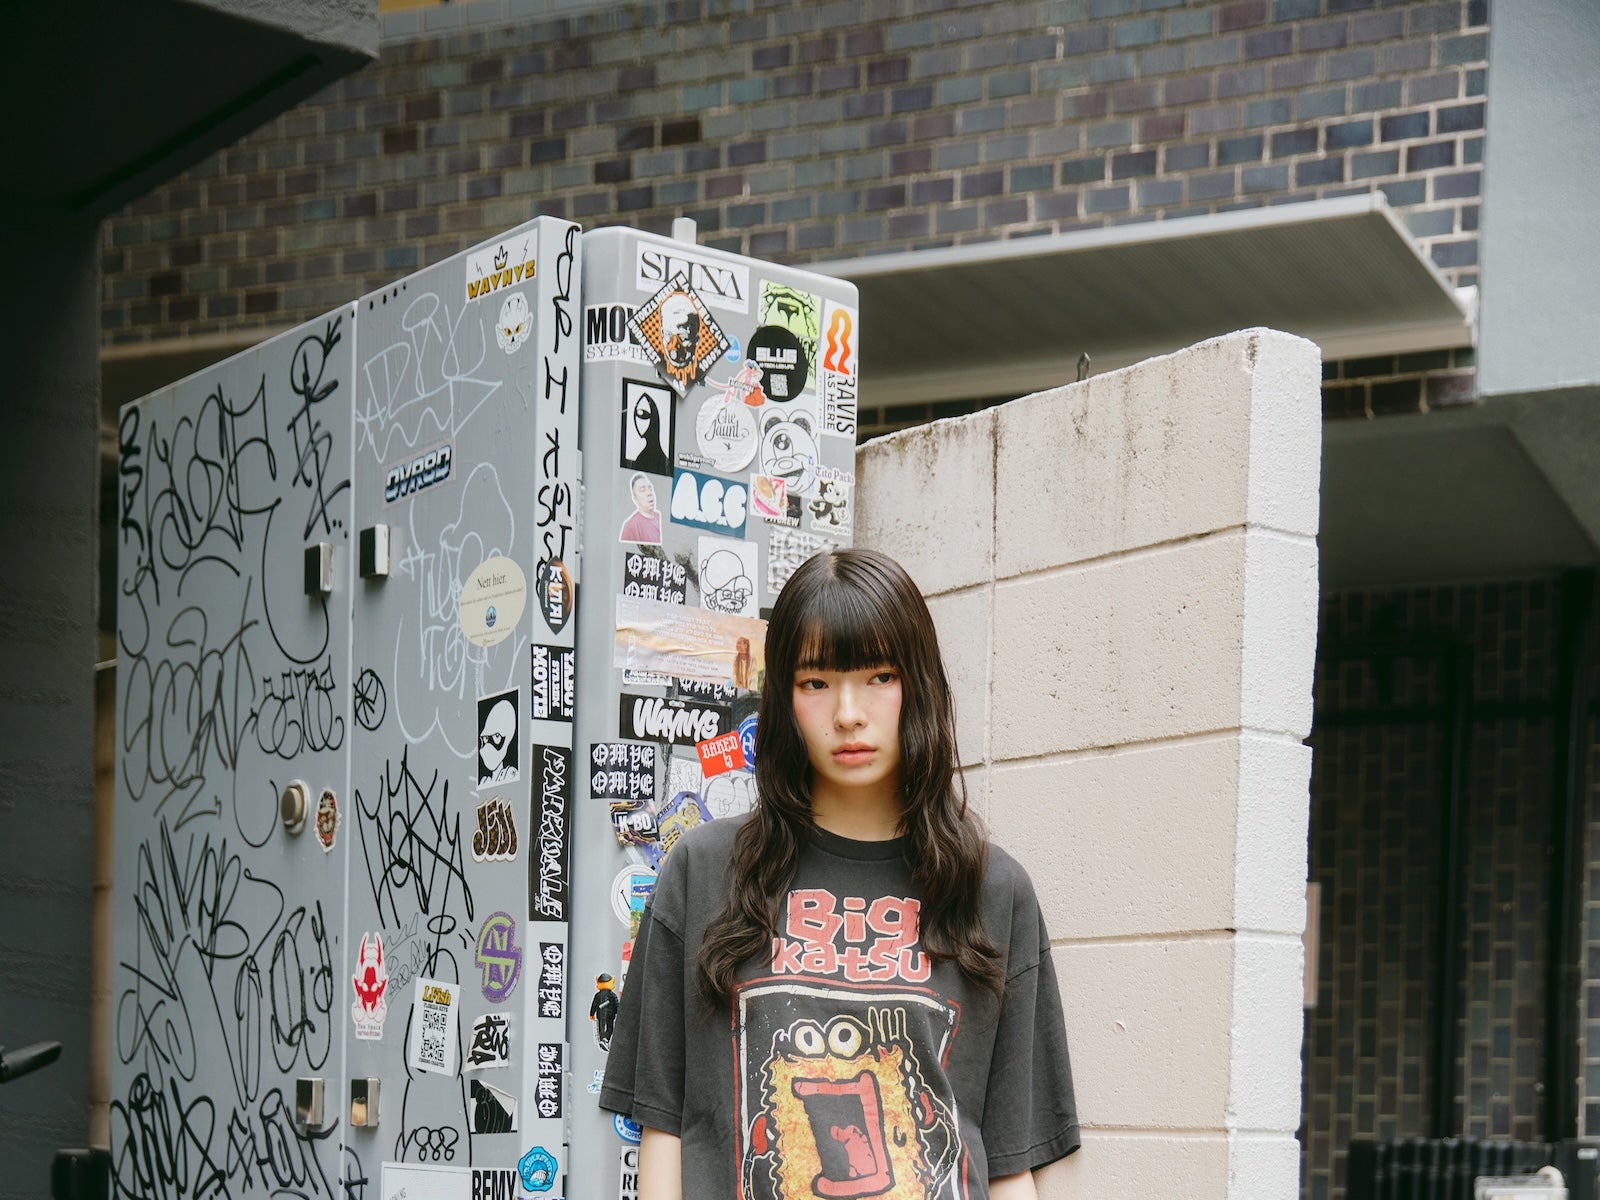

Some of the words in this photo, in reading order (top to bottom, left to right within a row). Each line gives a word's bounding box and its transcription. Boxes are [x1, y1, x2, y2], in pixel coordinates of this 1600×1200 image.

[827, 394, 836, 430] HERE
[477, 577, 491, 590] Nett
[492, 573, 507, 587] hier.
[532, 646, 548, 718] MOVIE
[700, 735, 738, 759] BAKED
[540, 748, 566, 919] PARKDALE
[786, 888, 921, 949] Big
